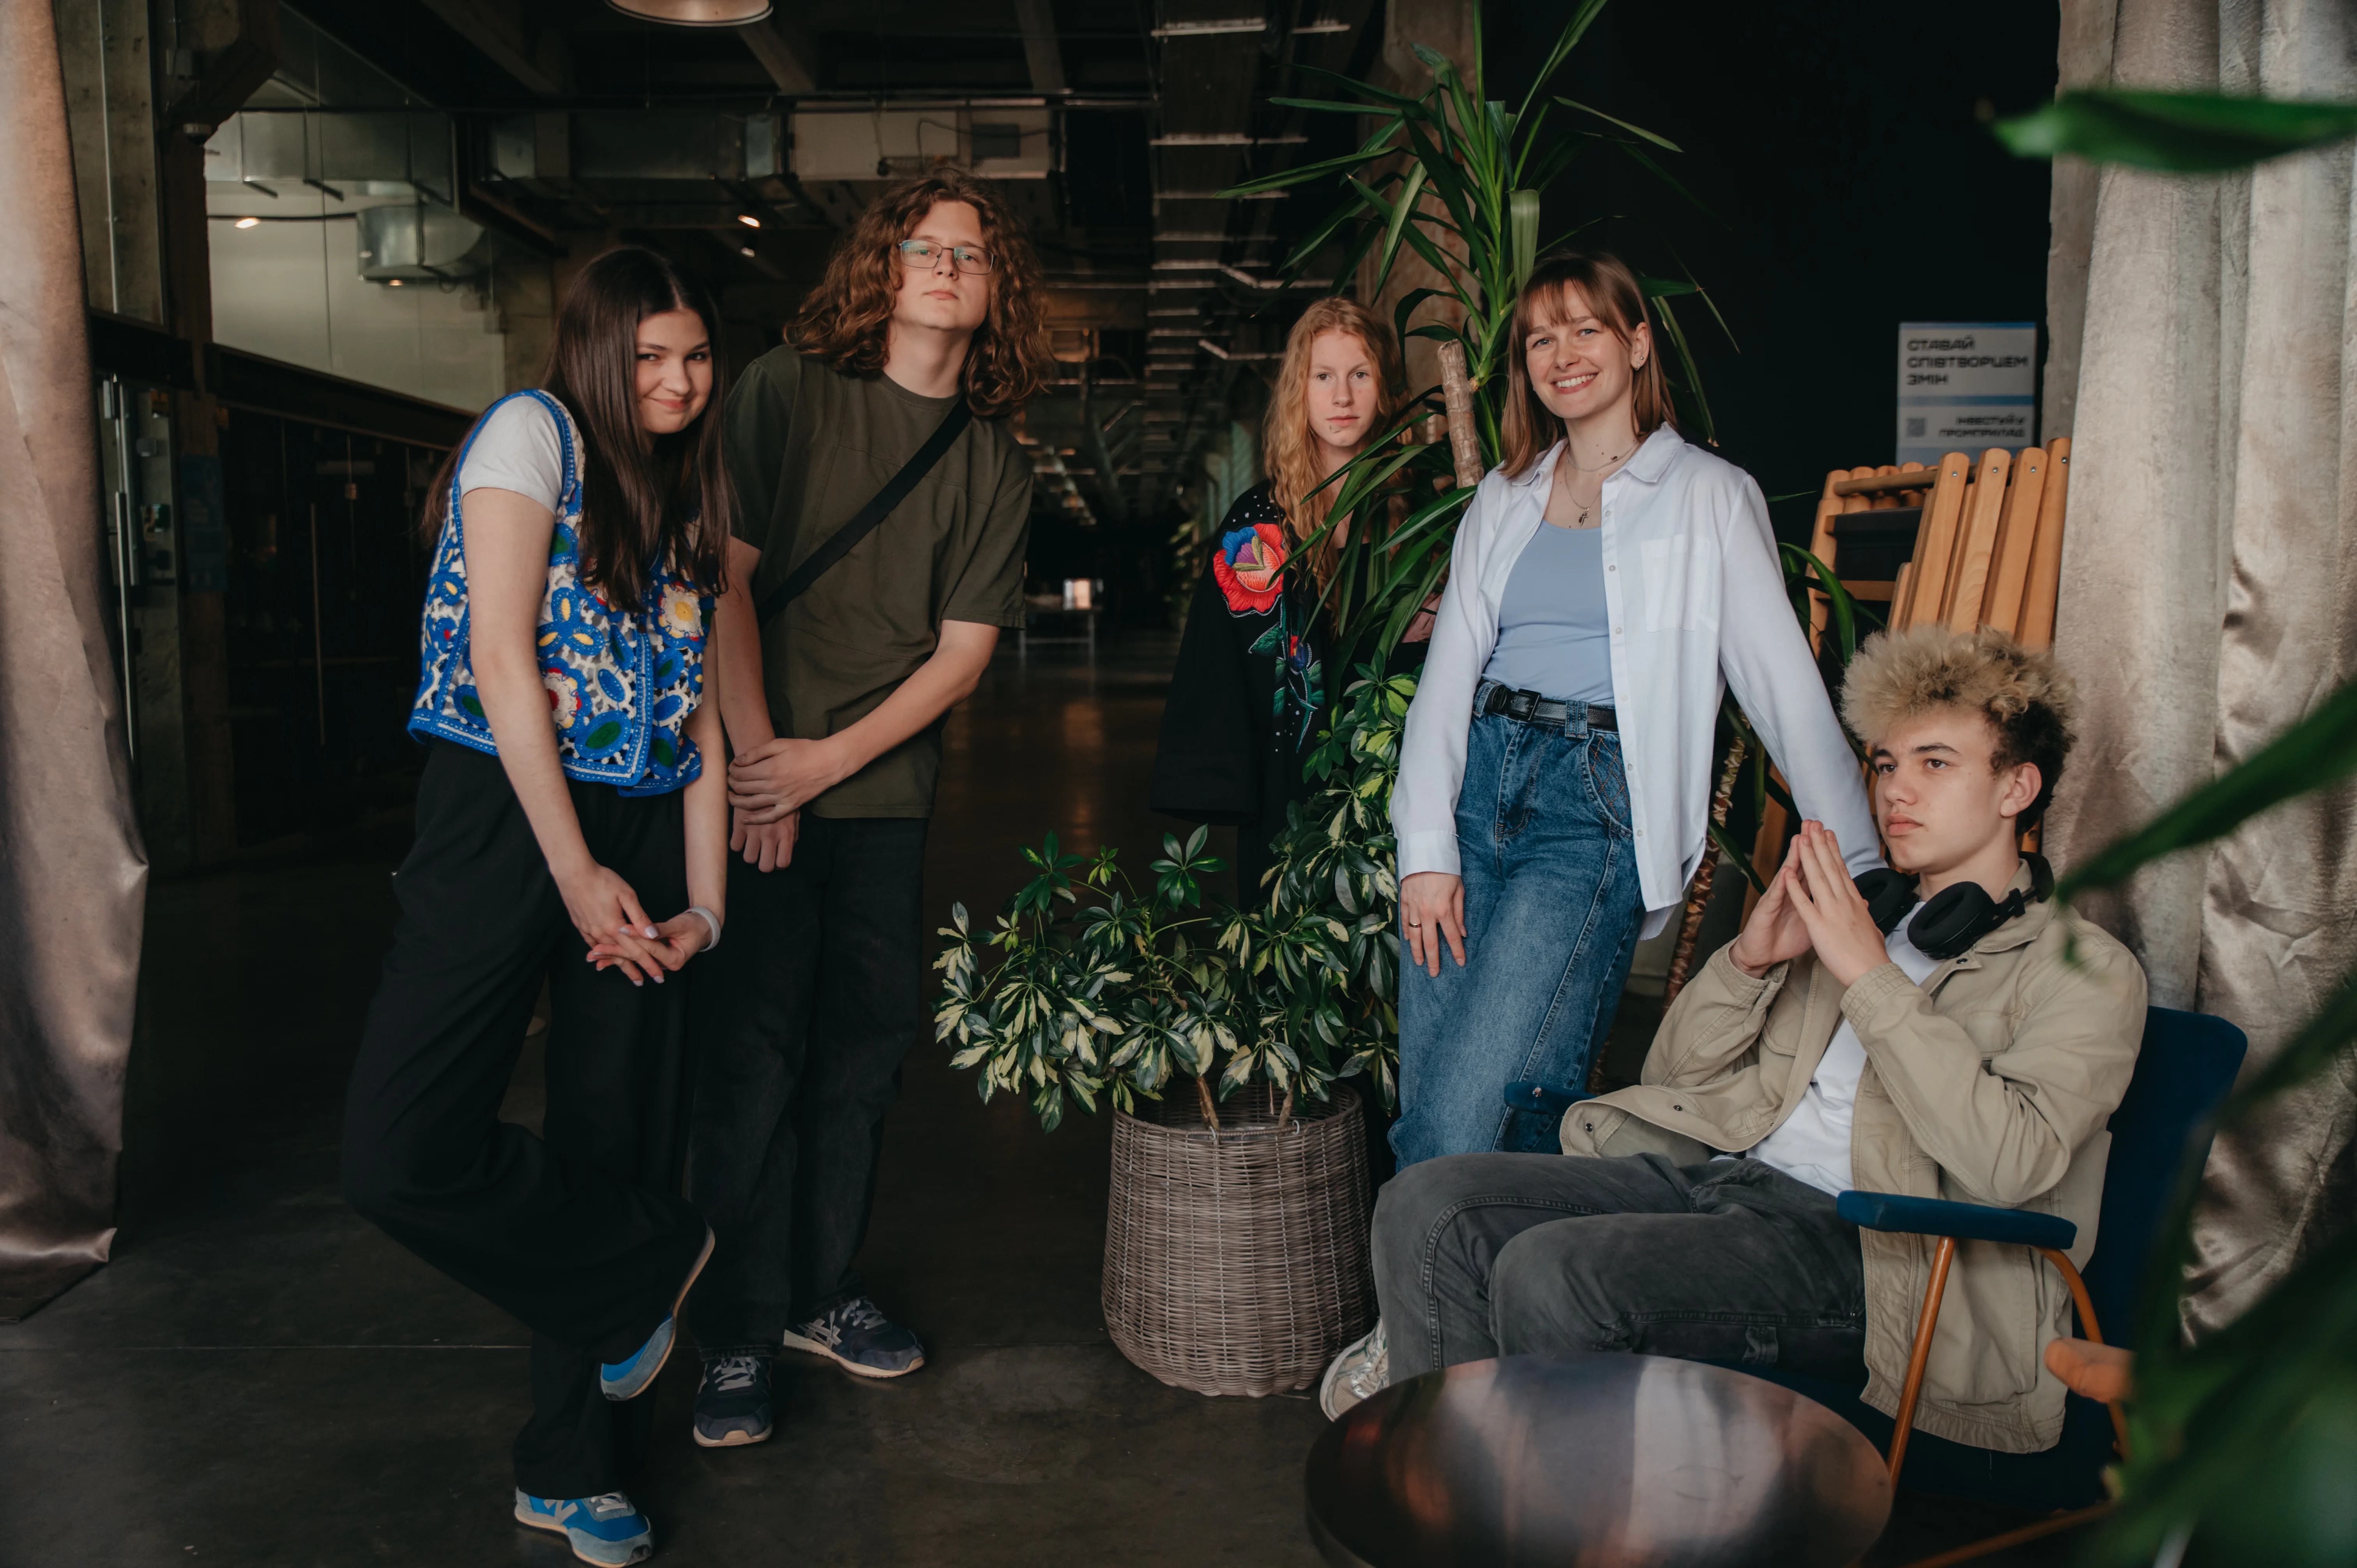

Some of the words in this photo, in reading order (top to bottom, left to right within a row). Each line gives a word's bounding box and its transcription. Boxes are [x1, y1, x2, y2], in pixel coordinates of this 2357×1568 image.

[1907, 335, 1974, 350] СТАВАЙ
[1907, 357, 2028, 368] СПІВТВОРЦЕМ
[1907, 374, 1947, 385] ЗМІН
